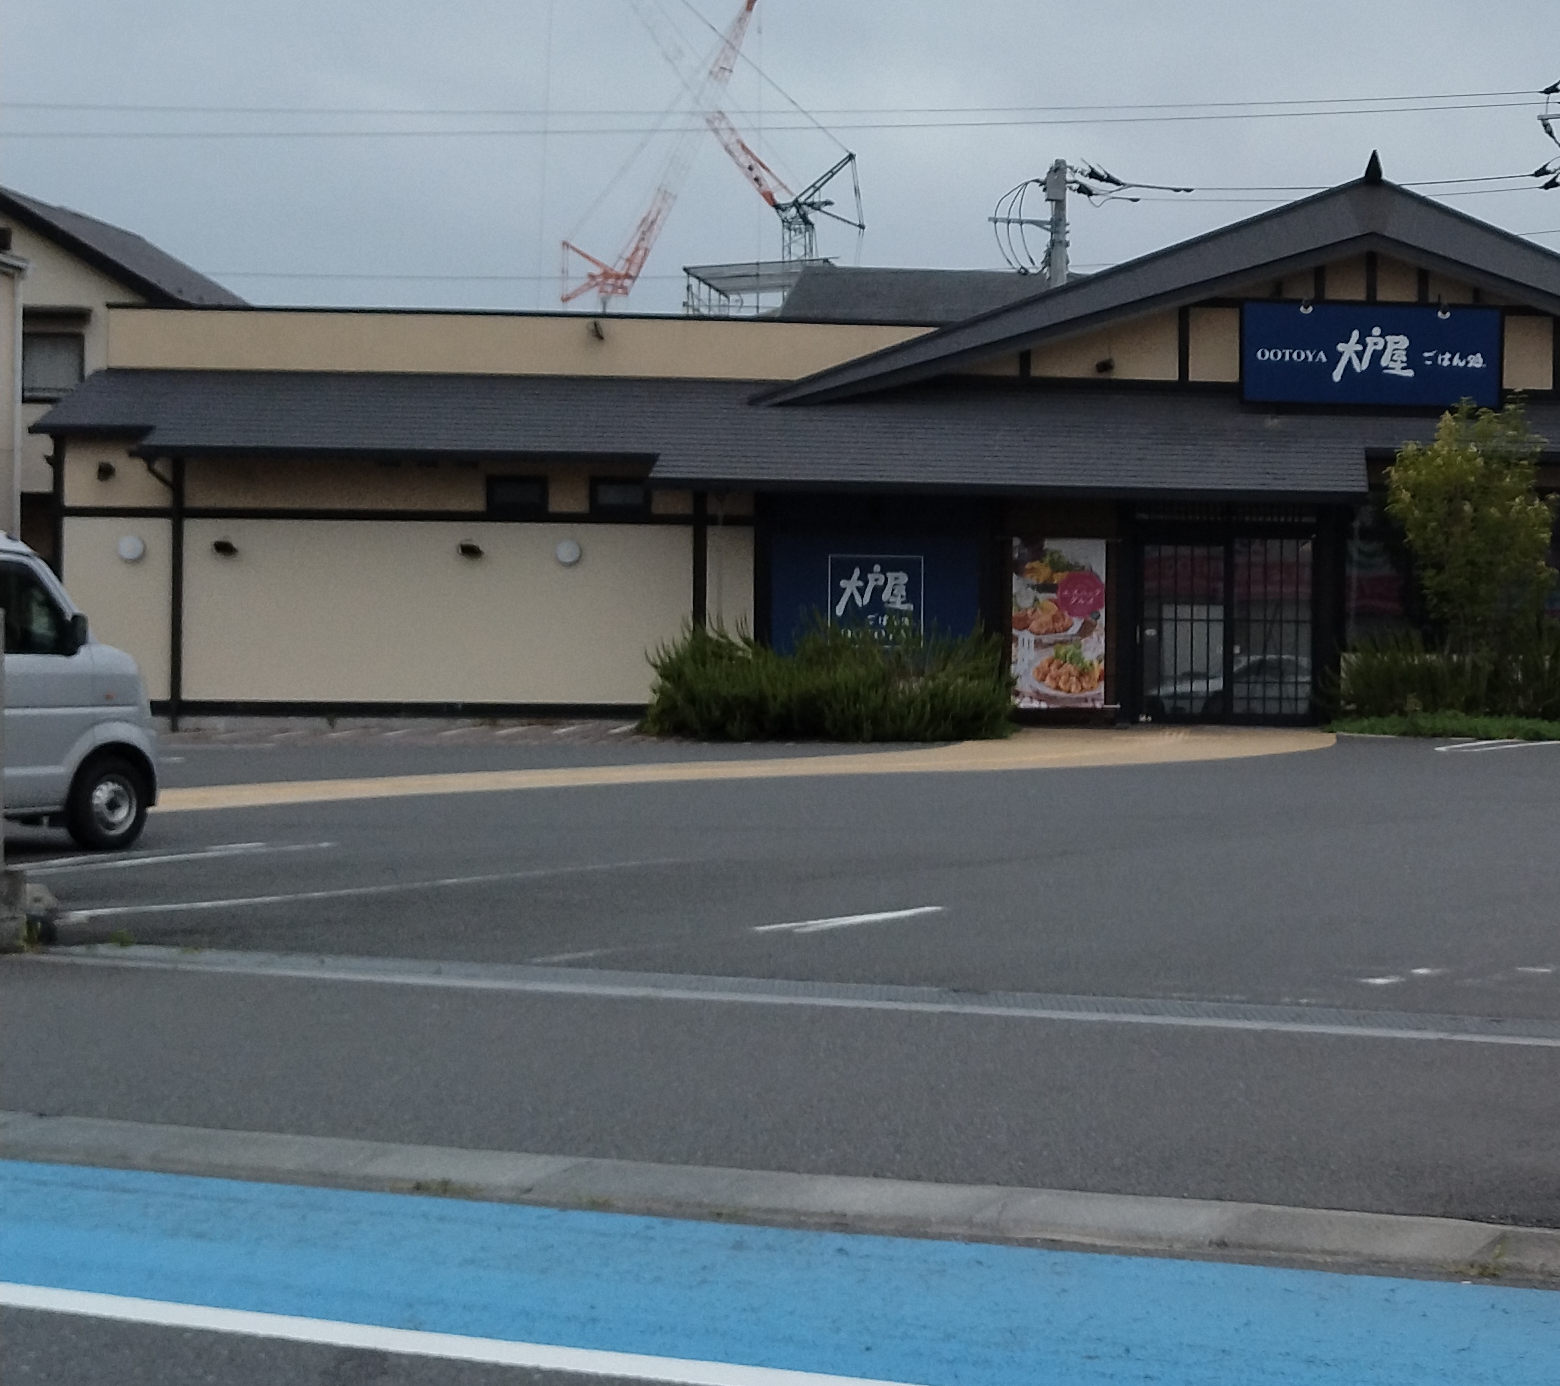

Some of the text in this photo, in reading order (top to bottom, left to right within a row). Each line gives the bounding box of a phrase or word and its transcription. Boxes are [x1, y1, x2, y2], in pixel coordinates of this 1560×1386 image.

[1256, 348, 1327, 363] OOTOYA
[1332, 326, 1415, 382] 大戸屋
[835, 564, 914, 617] 大戸屋
